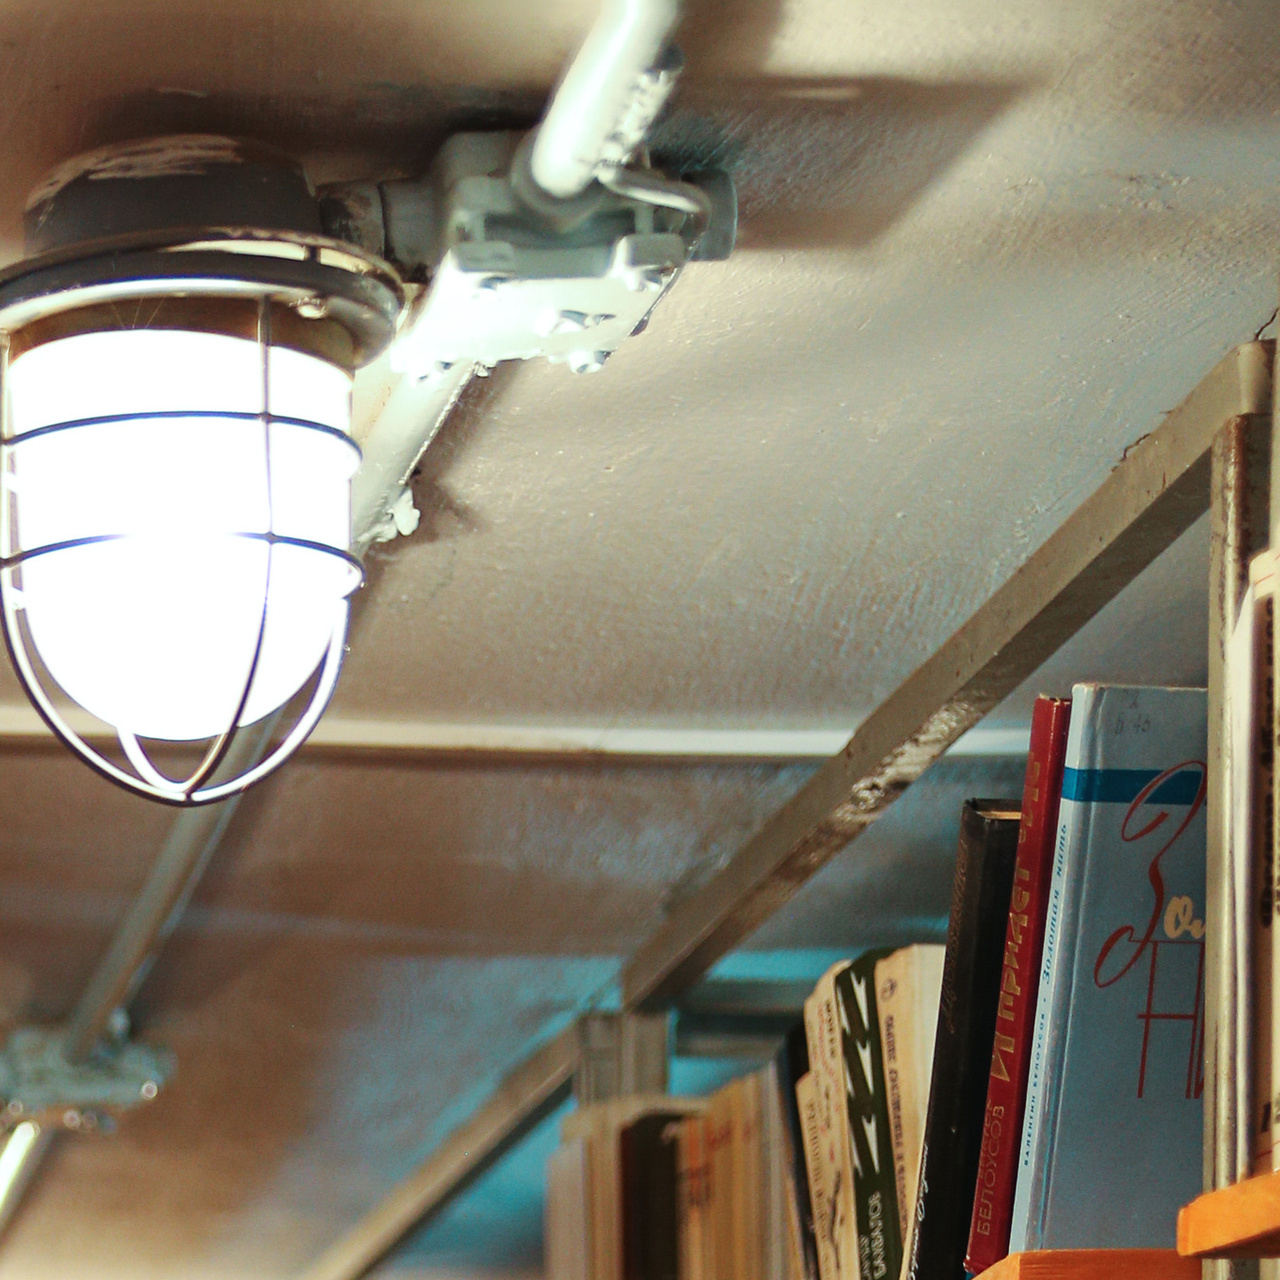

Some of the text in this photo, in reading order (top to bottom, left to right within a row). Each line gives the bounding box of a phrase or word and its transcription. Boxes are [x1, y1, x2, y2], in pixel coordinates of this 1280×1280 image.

[989, 1030, 1014, 1082] И
[1024, 822, 1068, 1166] ВАЛЕНТИН БЕЛОУСОВ Золотая нить
[976, 1104, 1005, 1236] БЕЛОУСОВ
